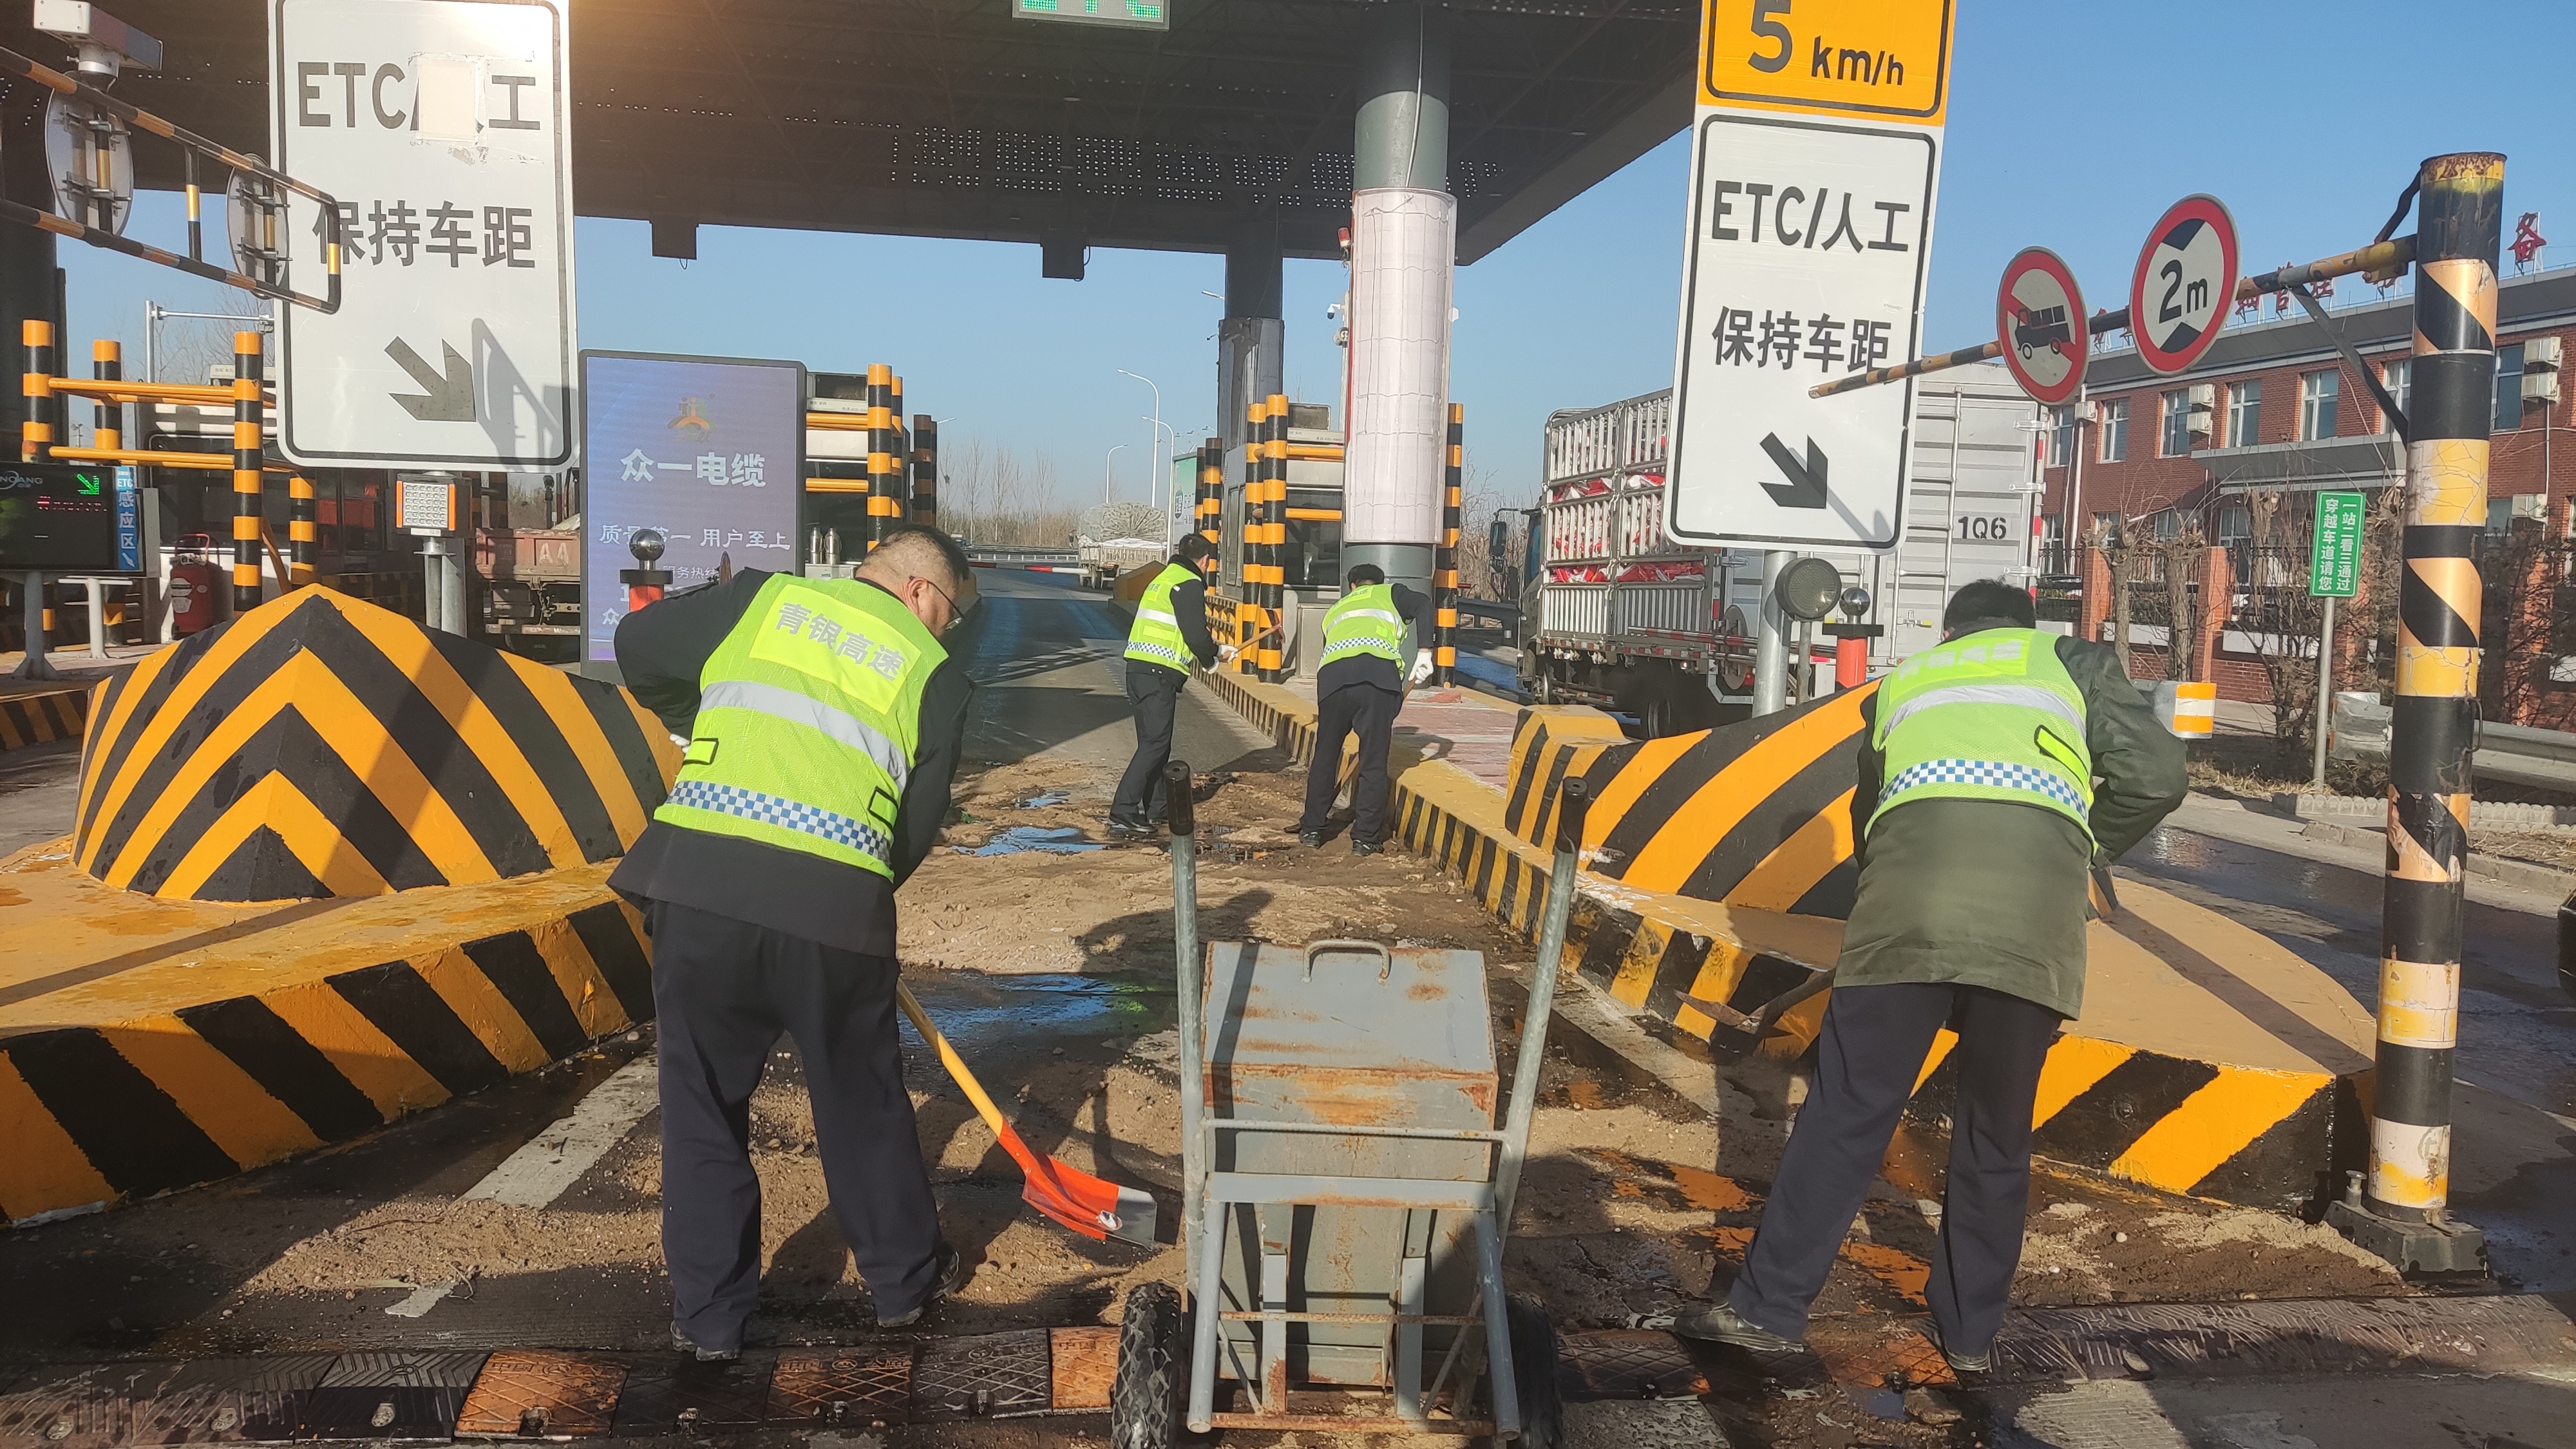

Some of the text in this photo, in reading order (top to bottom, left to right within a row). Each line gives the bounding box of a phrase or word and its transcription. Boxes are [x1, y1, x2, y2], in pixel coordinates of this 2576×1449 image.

[1748, 0, 1904, 86] 5 km/h
[298, 62, 540, 130] ETC工
[312, 200, 536, 268] 保持车距
[1712, 180, 1910, 253] ETC/人工
[1712, 306, 1891, 373] 保持车距
[620, 448, 766, 488] 众一电缆
[699, 529, 791, 550] 用户至上
[2318, 498, 2339, 591] 穿越车道请您
[2336, 504, 2358, 591] 一站二看三通过
[775, 602, 905, 681] 青银高速
